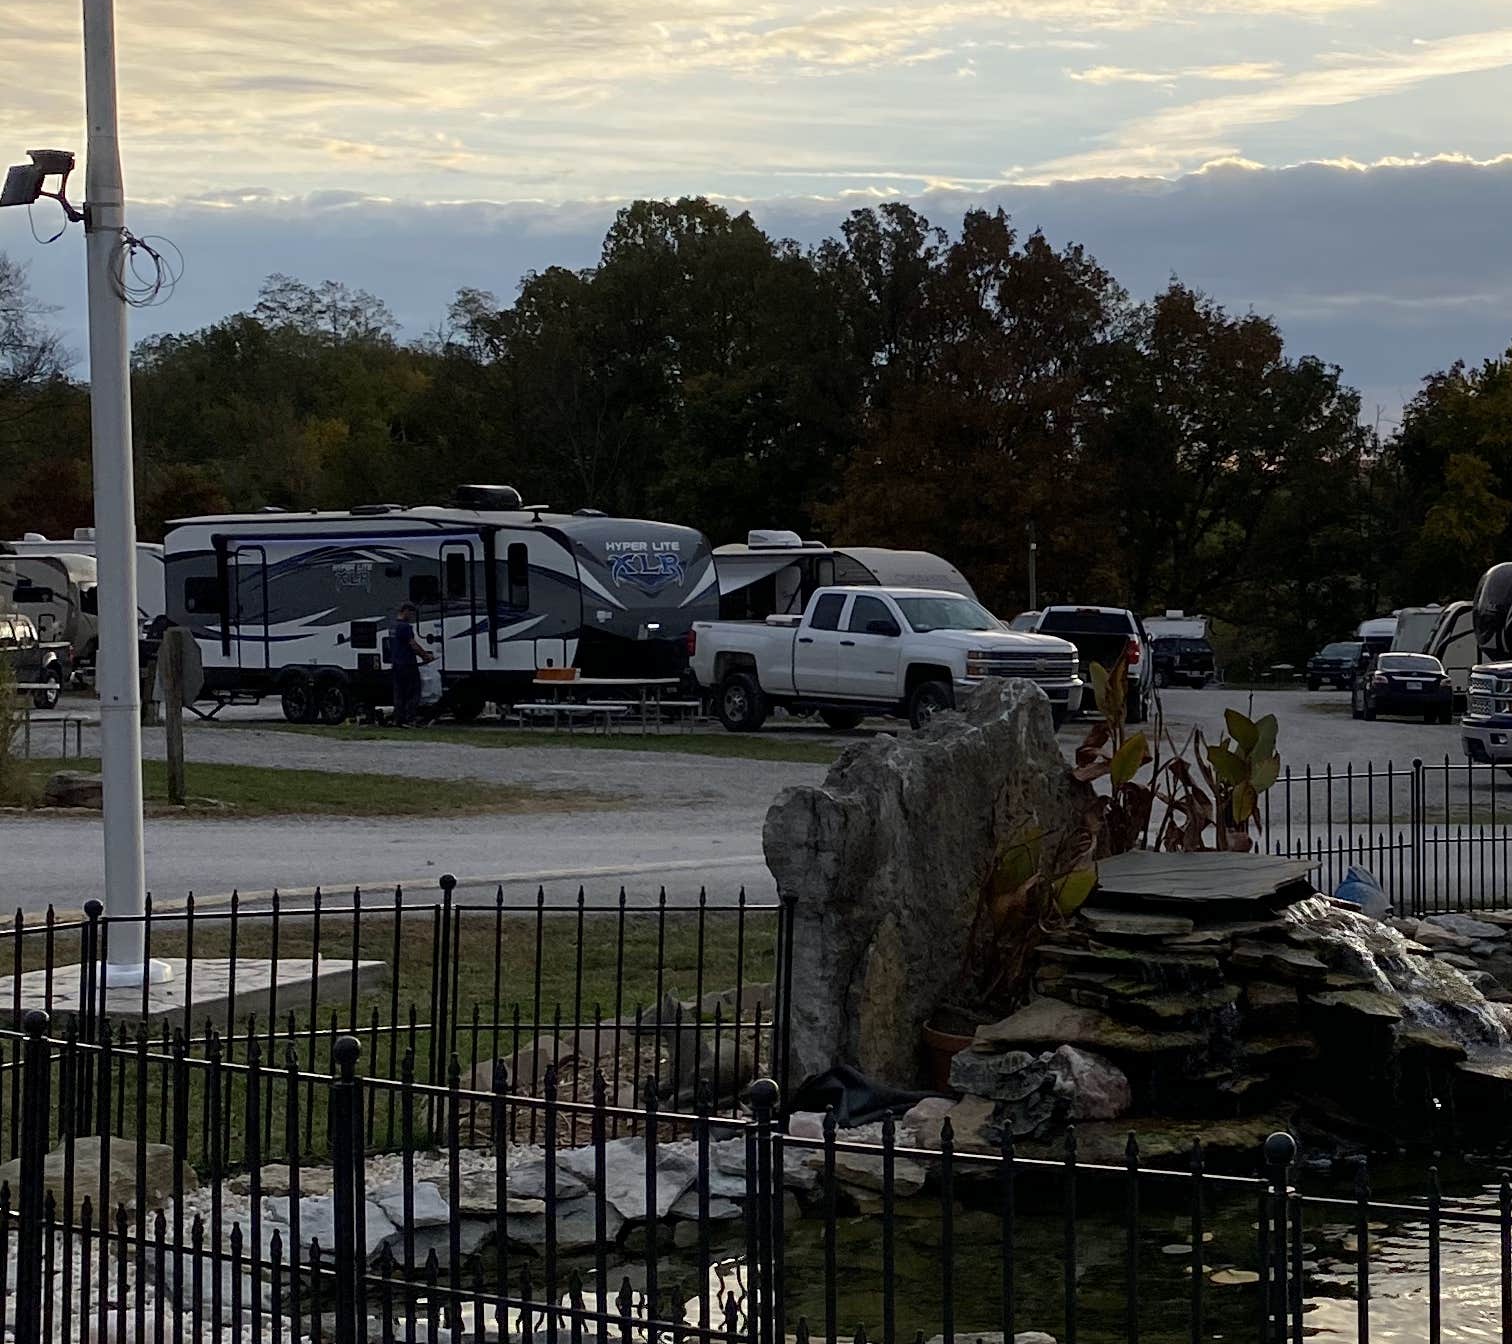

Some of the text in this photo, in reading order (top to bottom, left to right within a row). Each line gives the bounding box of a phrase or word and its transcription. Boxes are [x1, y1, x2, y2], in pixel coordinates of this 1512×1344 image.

[605, 541, 680, 551] HYPER LITE
[608, 552, 684, 587] XLR
